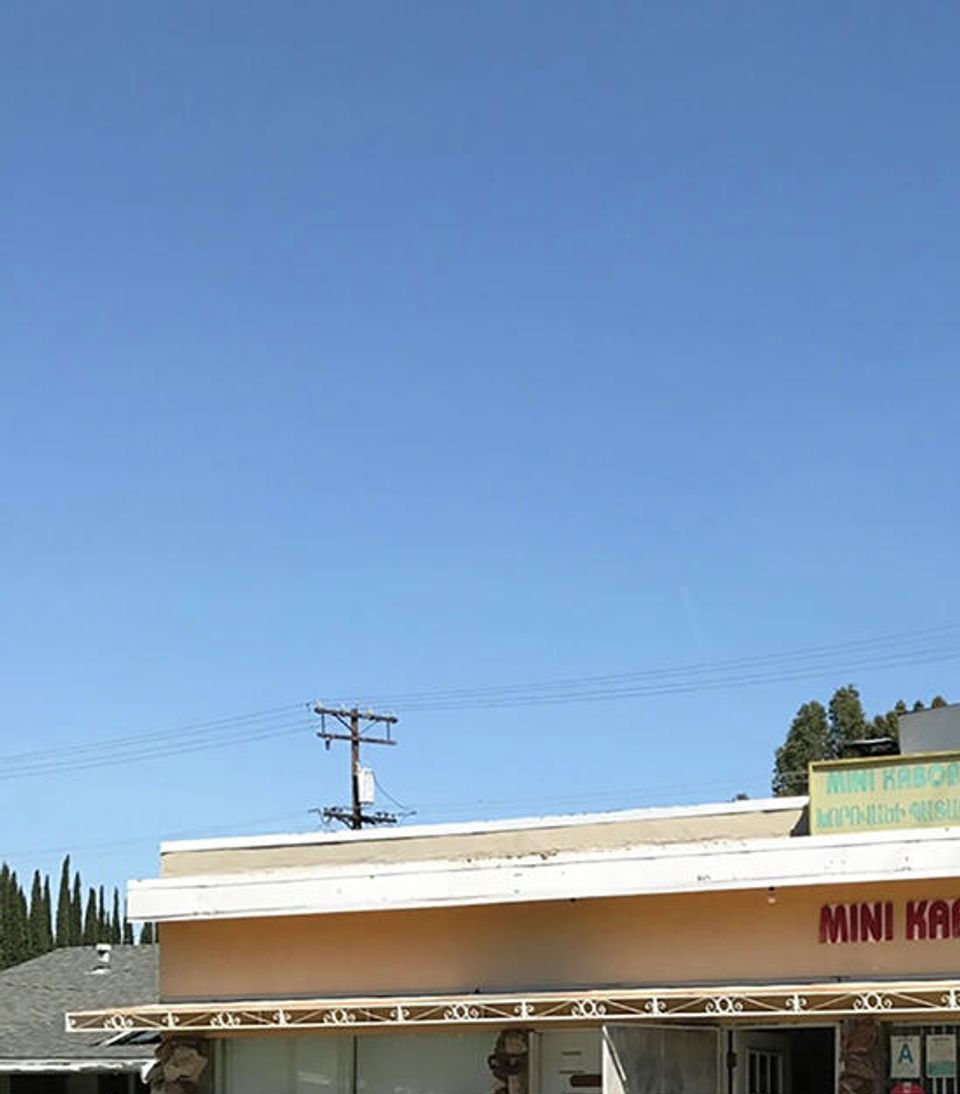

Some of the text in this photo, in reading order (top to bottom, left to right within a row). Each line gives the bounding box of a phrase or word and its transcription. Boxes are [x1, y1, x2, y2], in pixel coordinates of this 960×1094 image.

[827, 762, 960, 795] MINI KABOB
[818, 901, 894, 944] MINI
[897, 1043, 914, 1064] A
